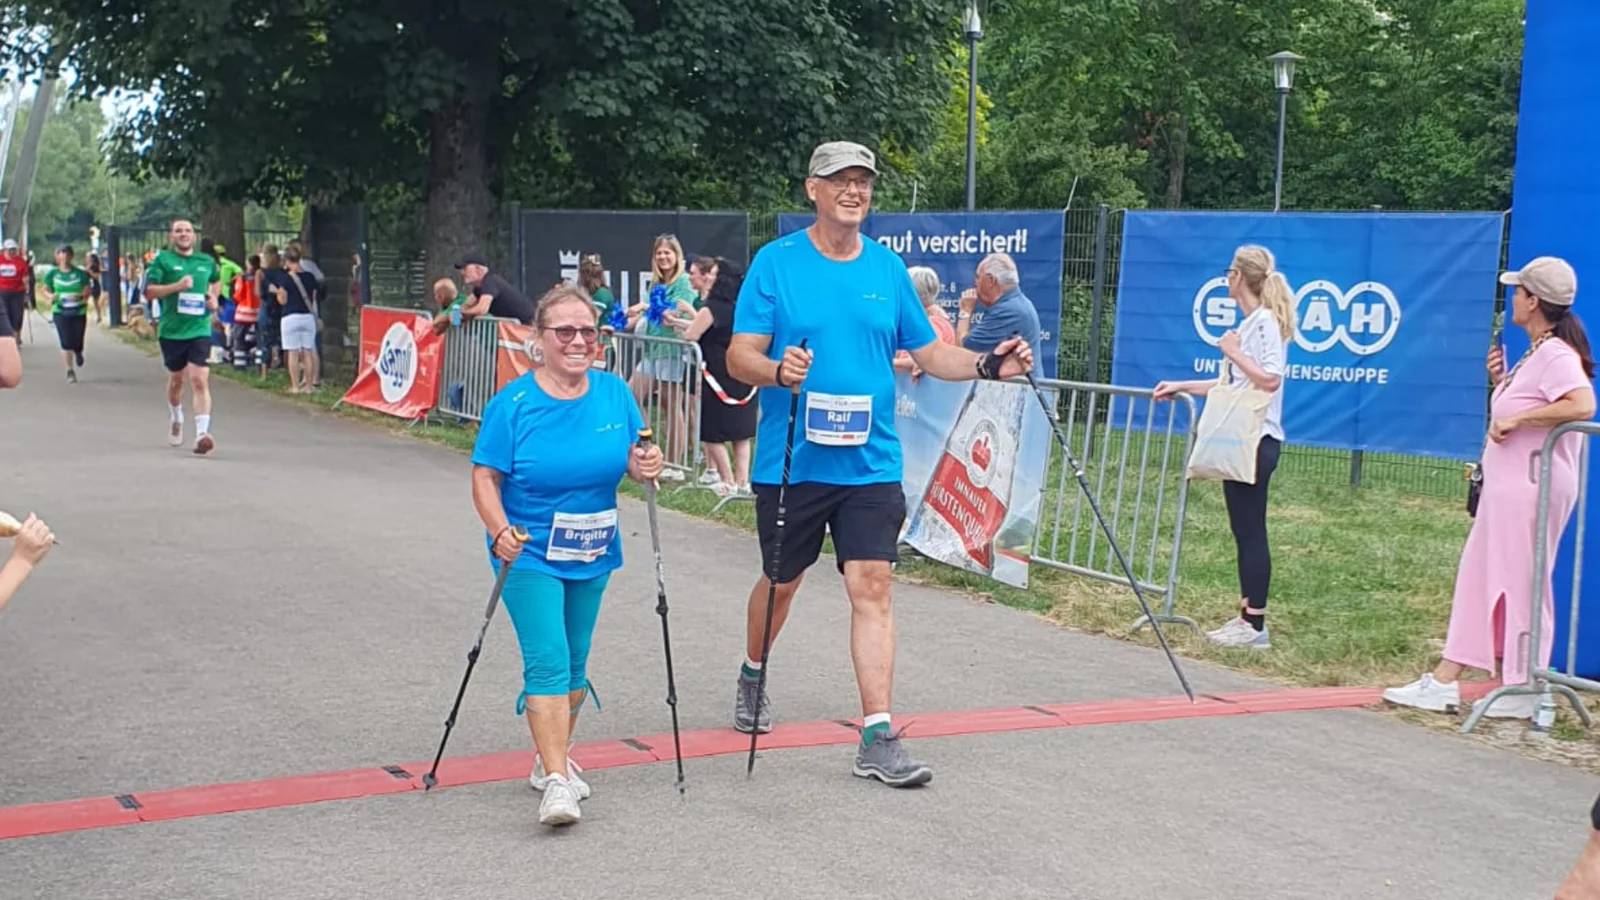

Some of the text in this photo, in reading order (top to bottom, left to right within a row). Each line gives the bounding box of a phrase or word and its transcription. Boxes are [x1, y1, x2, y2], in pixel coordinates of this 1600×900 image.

[918, 229, 1028, 253] versichert!
[1206, 296, 1386, 334] SÄH
[1194, 358, 1388, 384] UNTENSGRUPPE
[827, 411, 852, 423] Ralf
[565, 528, 608, 544] Brigitte
